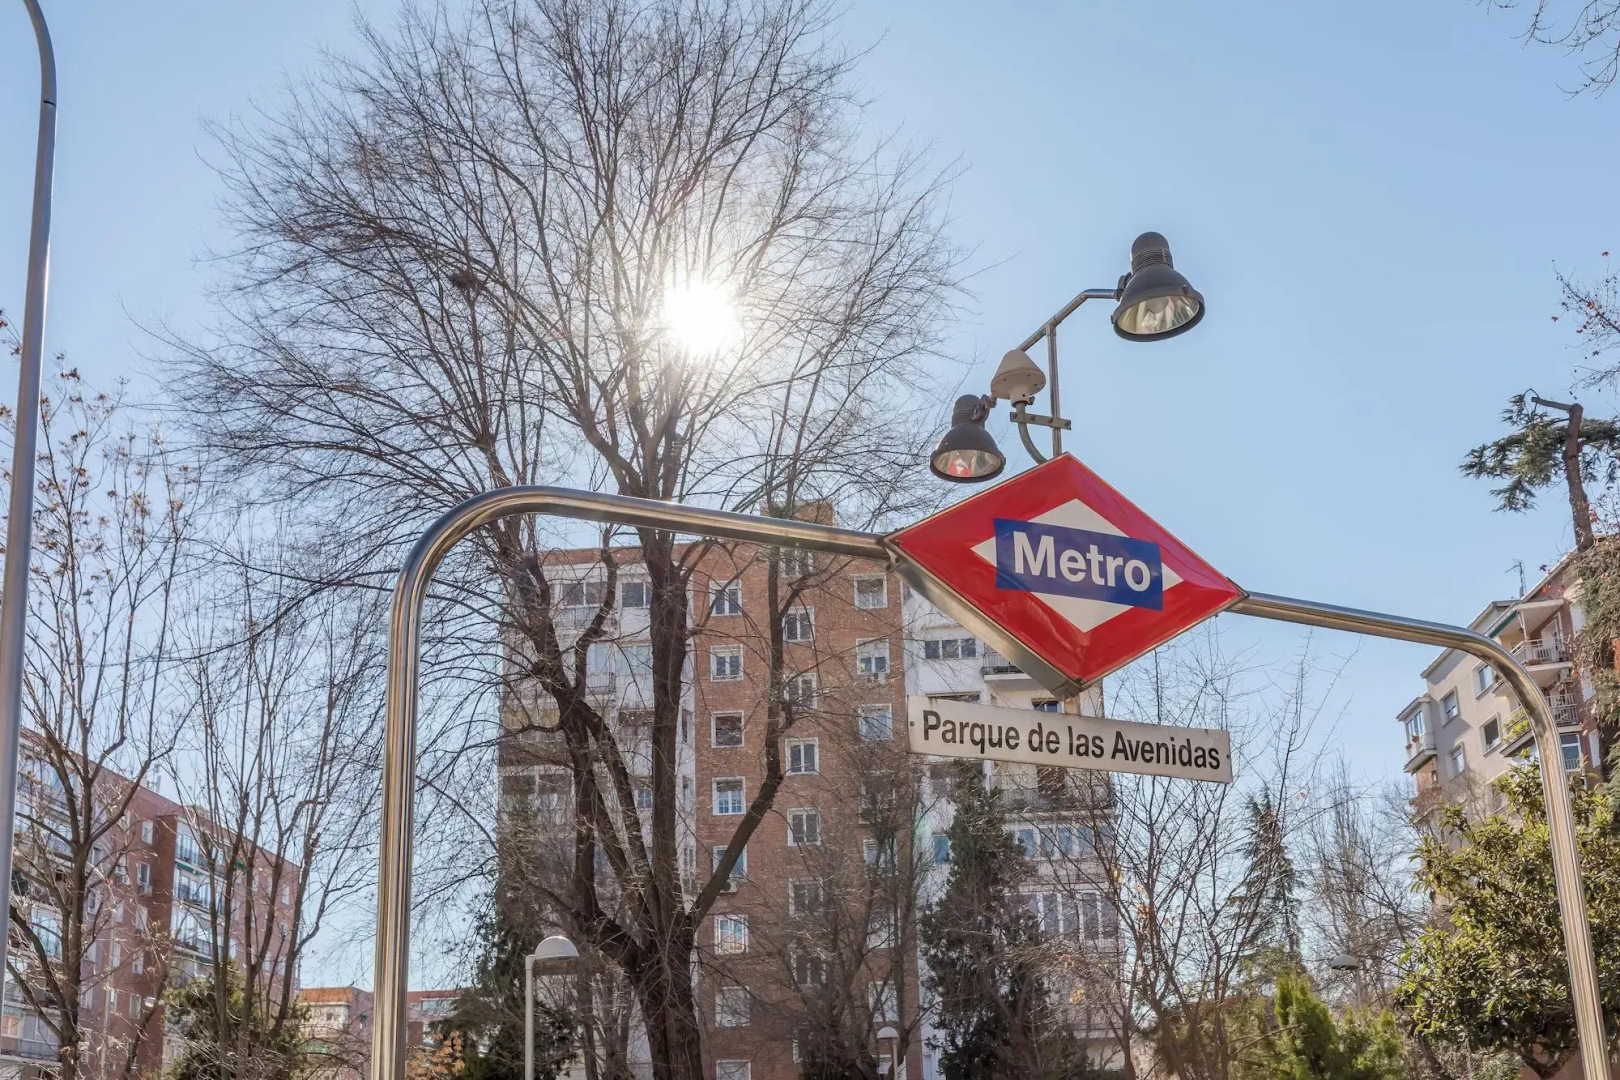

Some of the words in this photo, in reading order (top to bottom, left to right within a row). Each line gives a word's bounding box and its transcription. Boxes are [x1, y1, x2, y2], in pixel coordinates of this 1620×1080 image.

[1013, 531, 1151, 592] Metro
[922, 710, 1020, 754] Parque
[1027, 722, 1061, 755] de
[1068, 725, 1105, 760] las
[1111, 731, 1221, 770] Avenidas
